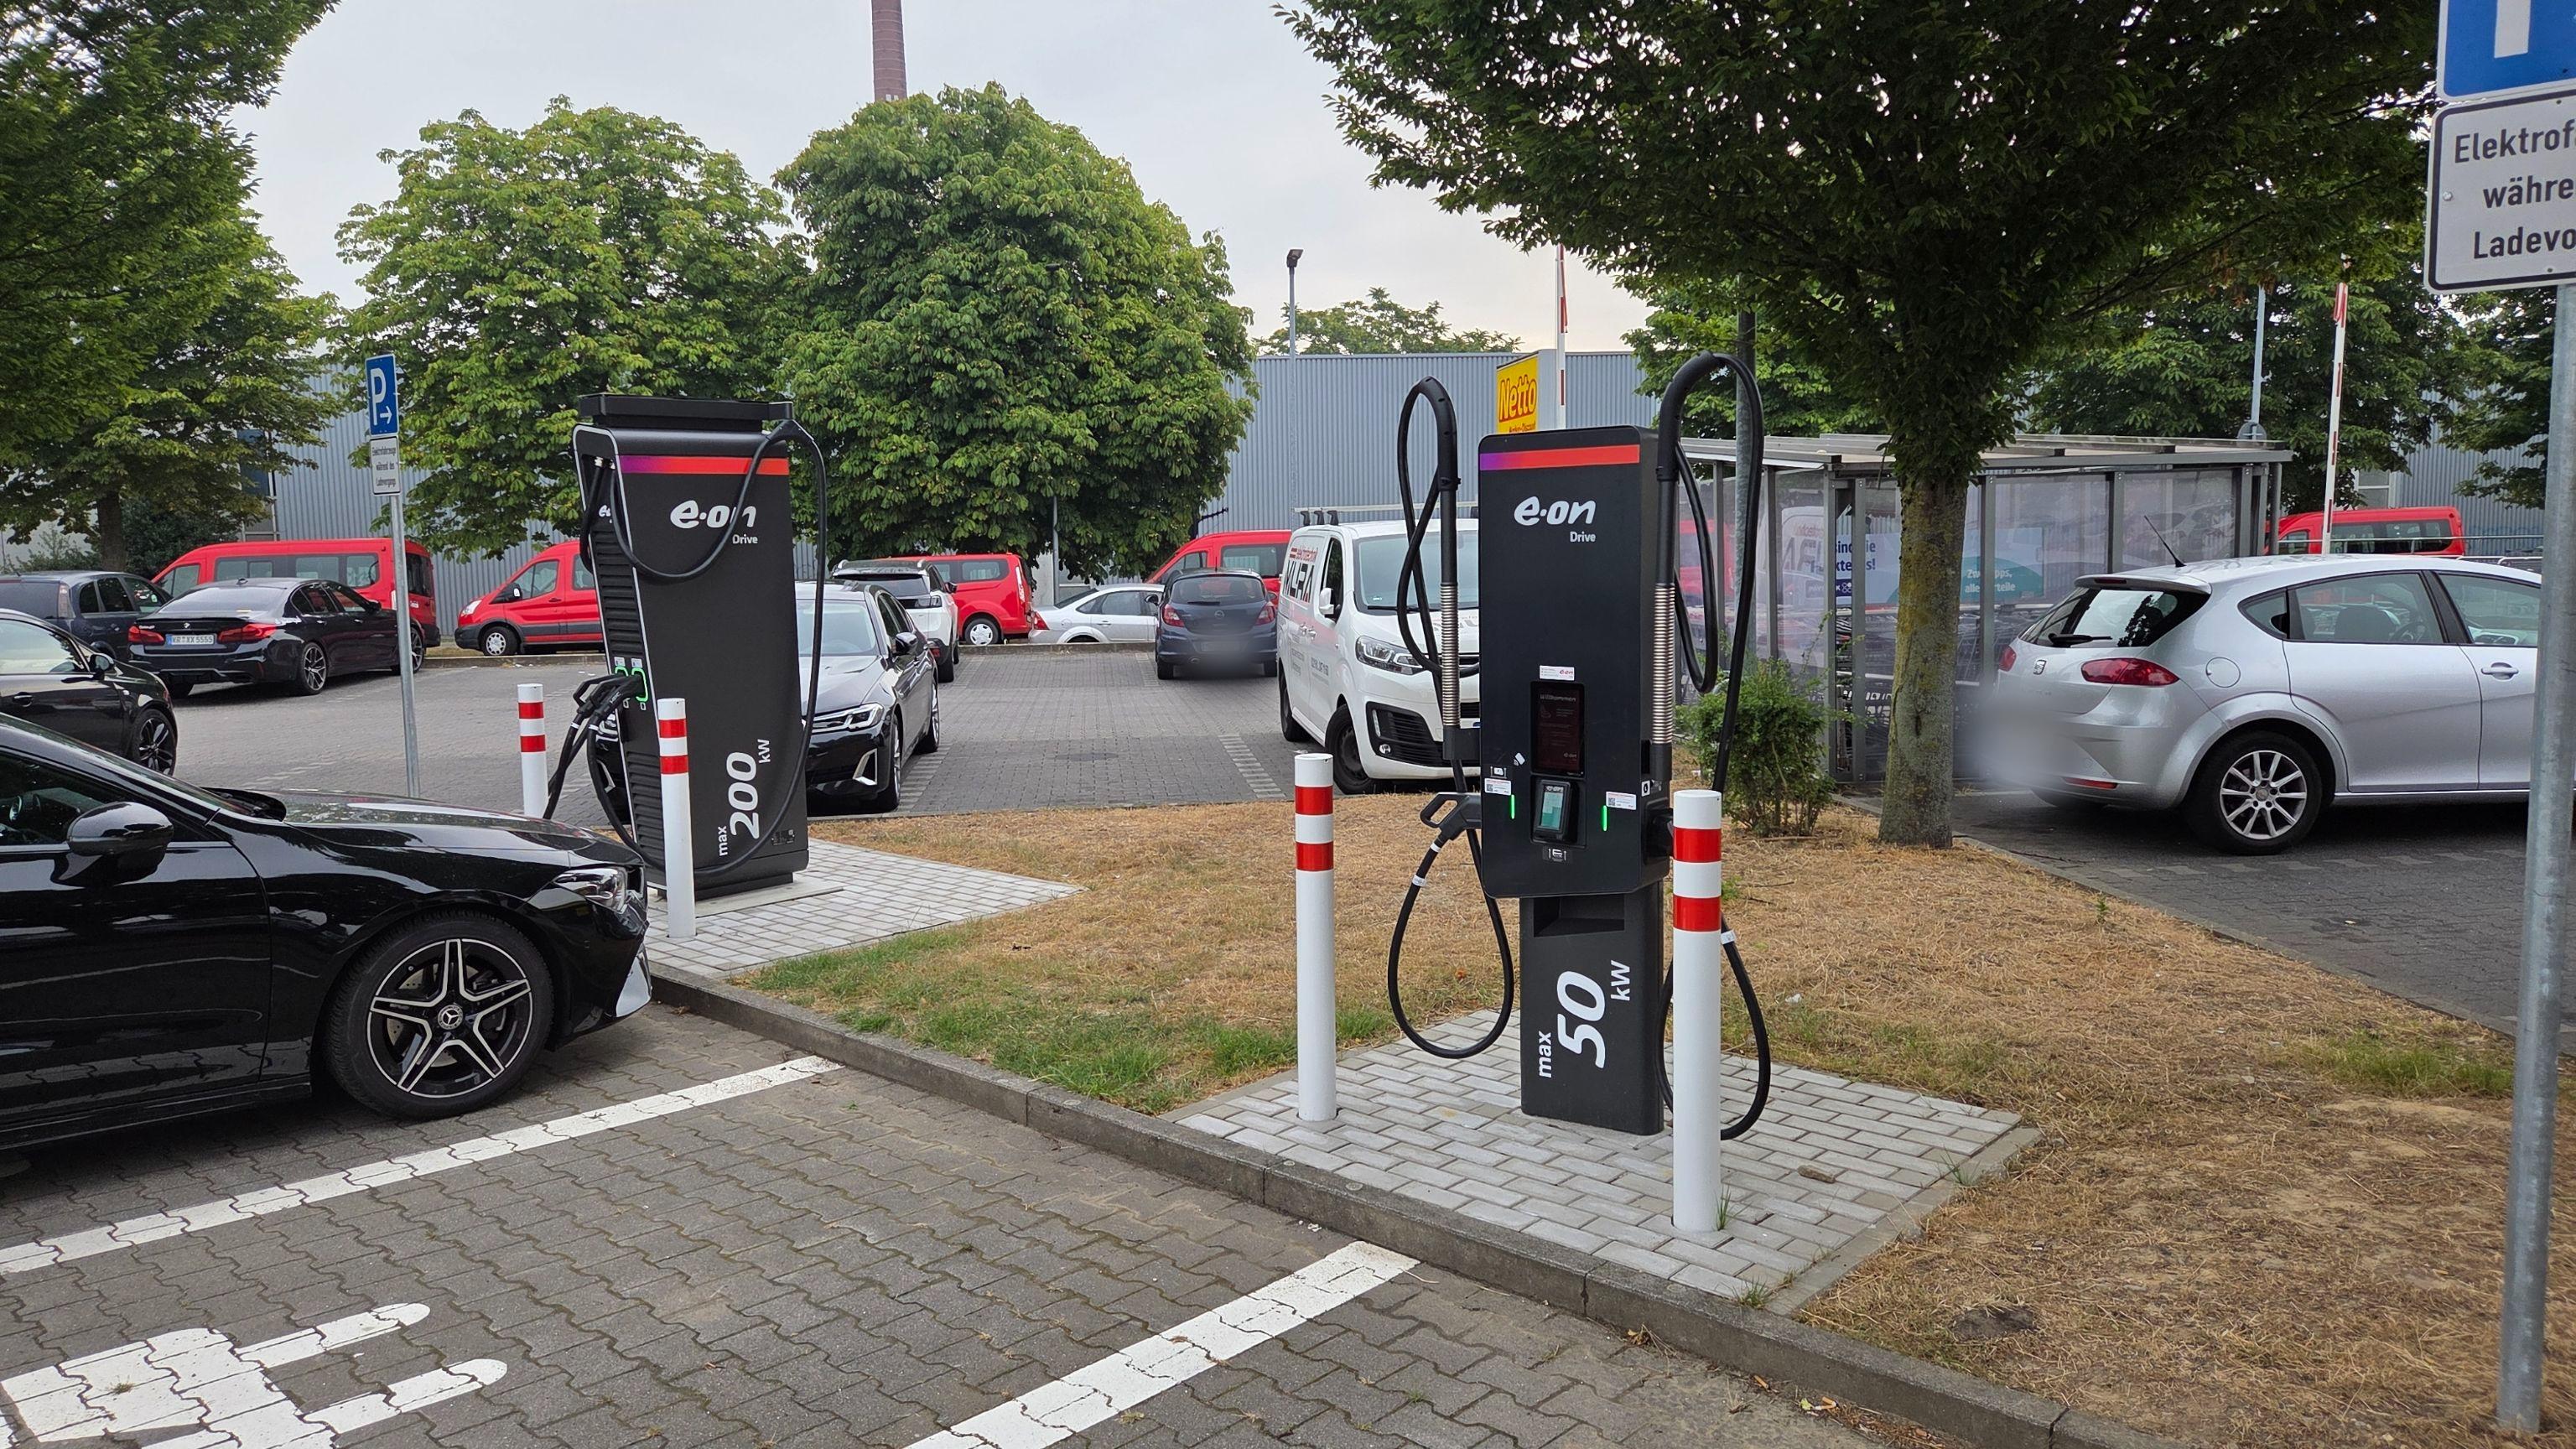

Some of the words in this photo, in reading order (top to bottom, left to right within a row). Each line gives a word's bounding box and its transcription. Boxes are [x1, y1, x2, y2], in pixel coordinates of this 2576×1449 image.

[2454, 118, 2576, 164] Elektrof
[370, 367, 387, 426] P
[1498, 374, 1537, 423] Netto
[732, 533, 758, 544] Drive
[1570, 531, 1596, 543] Drive
[757, 739, 771, 764] kW
[726, 751, 760, 839] 200
[718, 825, 728, 856] max
[1610, 959, 1631, 1001] kW
[1556, 970, 1606, 1069] 50
[1538, 1031, 1552, 1078] max
